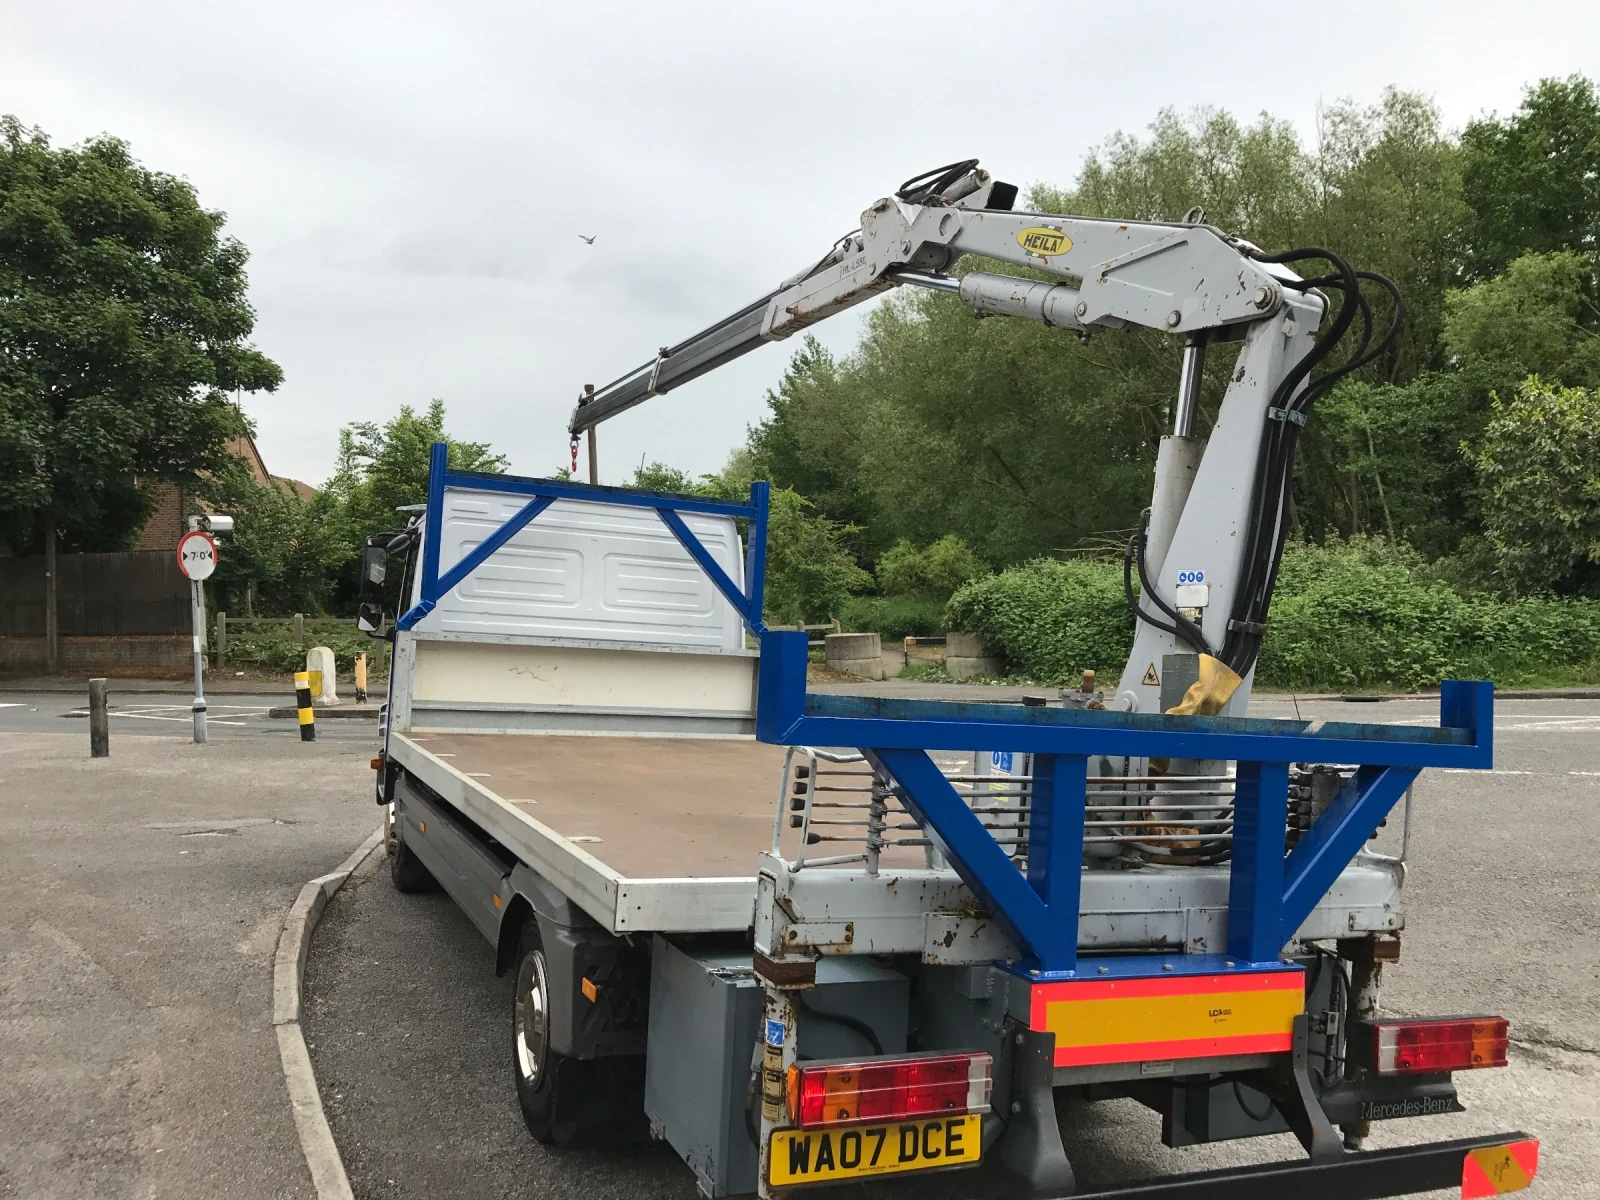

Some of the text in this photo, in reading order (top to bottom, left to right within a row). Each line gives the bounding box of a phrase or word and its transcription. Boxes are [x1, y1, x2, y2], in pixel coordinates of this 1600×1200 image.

[1023, 233, 1058, 253] HEILA
[1360, 1096, 1453, 1119] Mercedes-Benz
[789, 1118, 966, 1176] WA07 DCE
